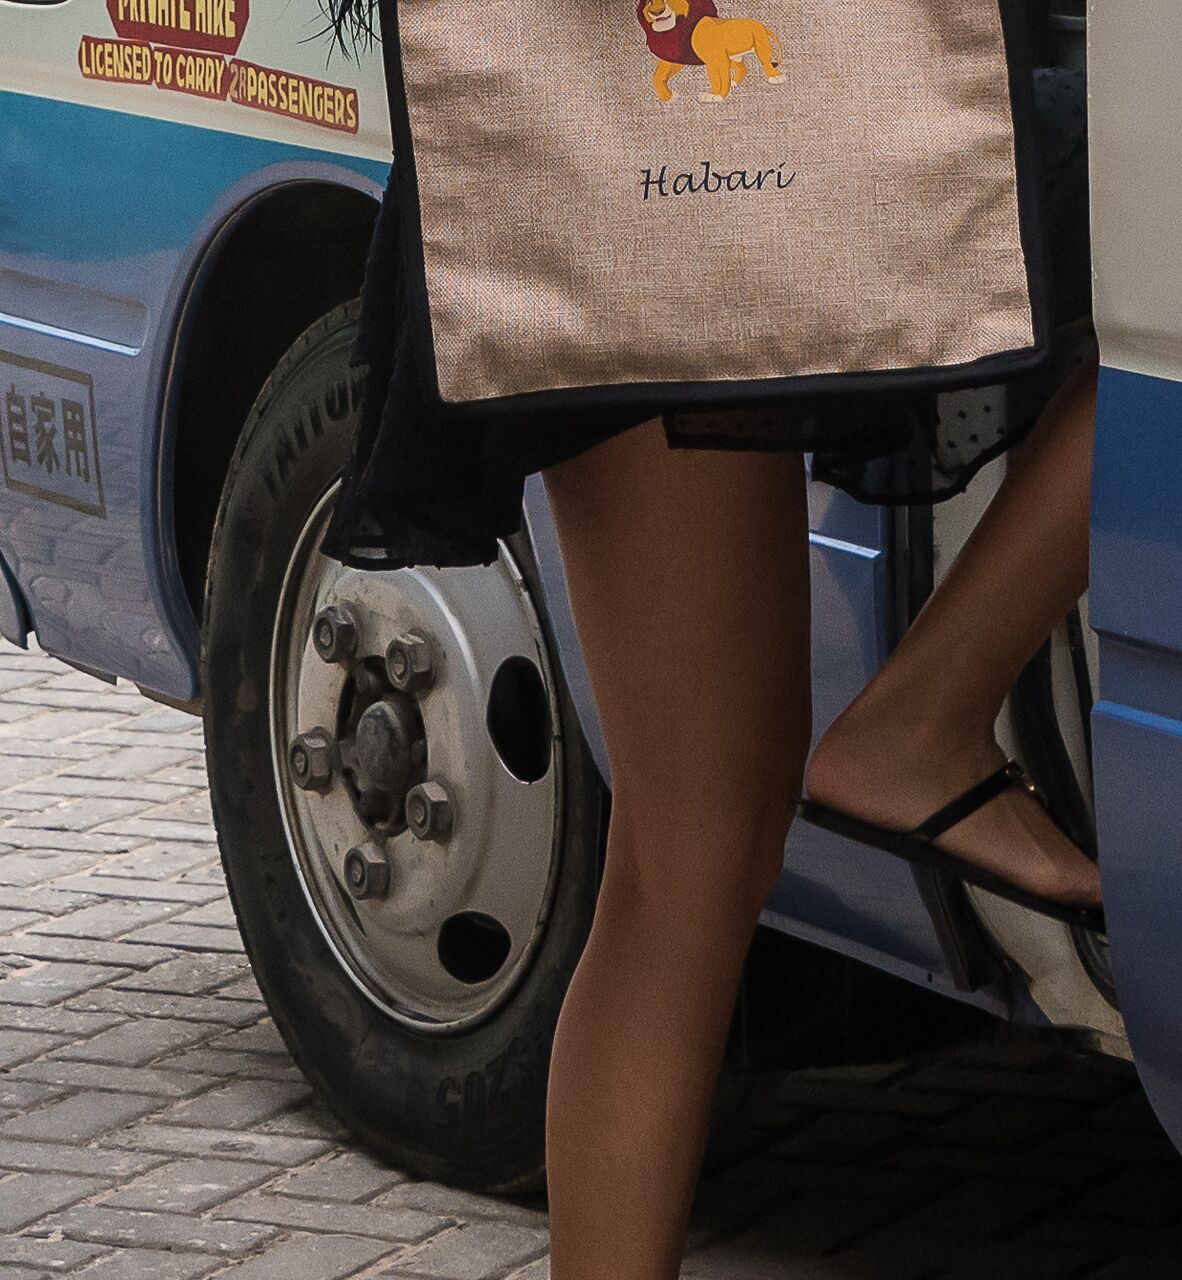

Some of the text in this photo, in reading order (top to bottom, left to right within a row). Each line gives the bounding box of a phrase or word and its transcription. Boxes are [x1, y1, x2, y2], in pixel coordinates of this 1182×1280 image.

[81, 41, 152, 82] LICENSED
[153, 51, 173, 85] TO
[175, 53, 226, 94] CARRY
[247, 66, 357, 129] PASSENGERS
[640, 160, 797, 201] Habari
[5, 382, 90, 484] 自家用
